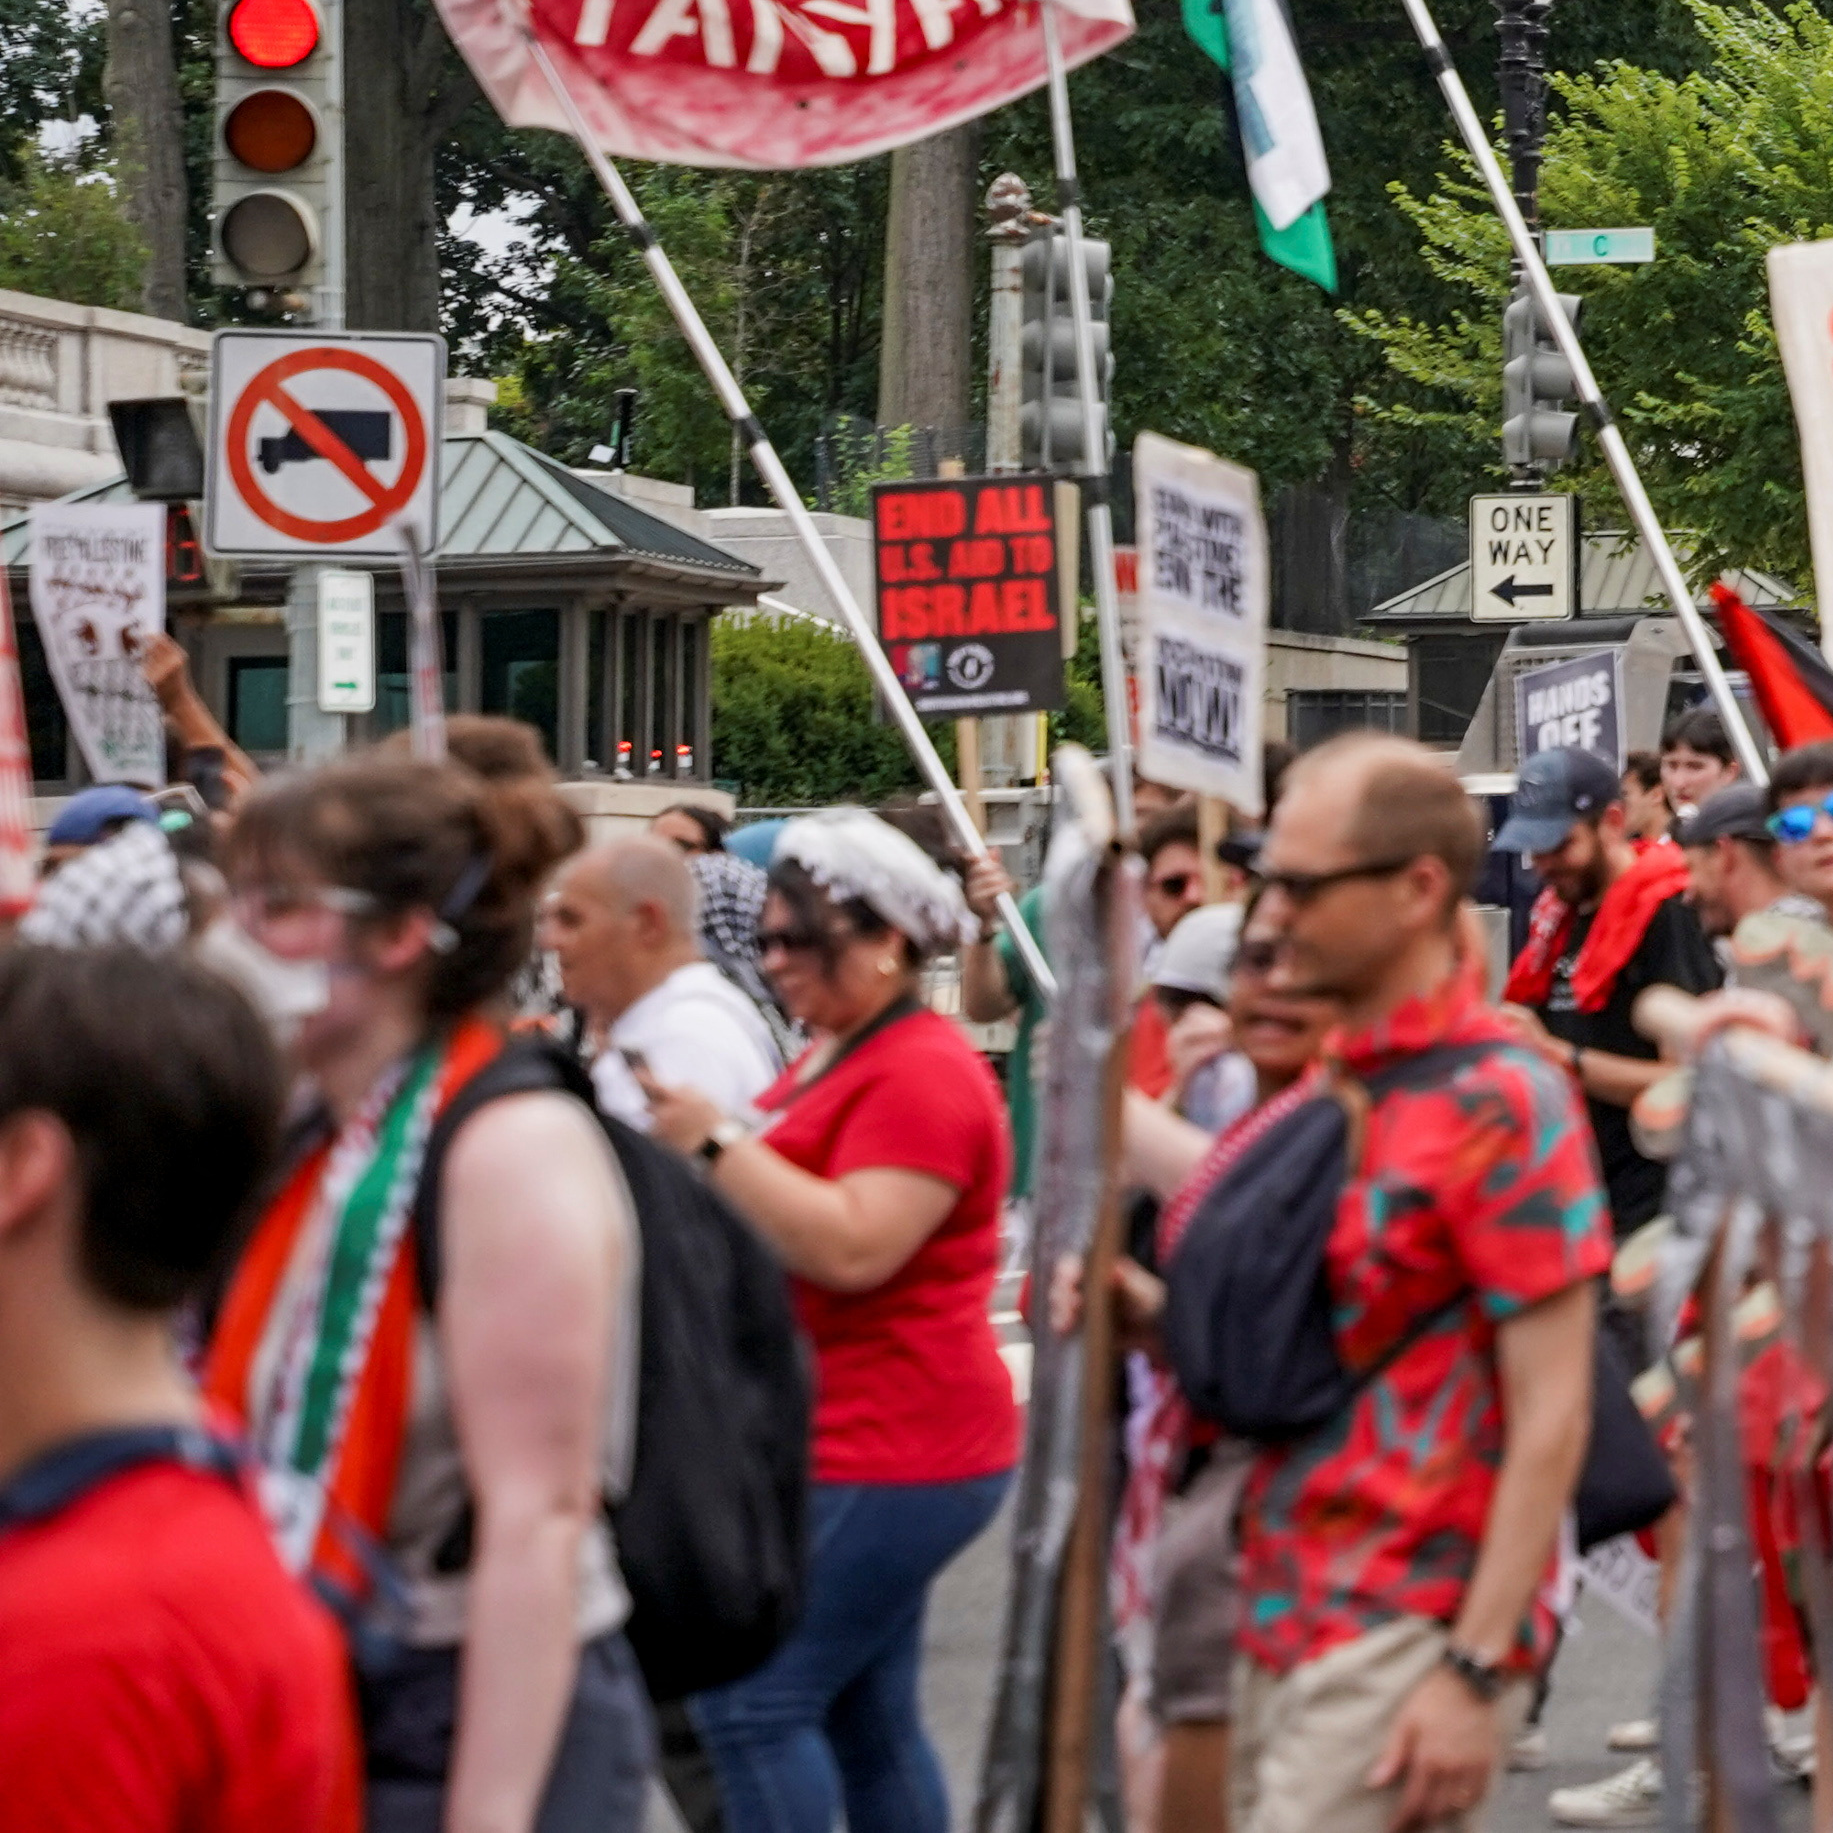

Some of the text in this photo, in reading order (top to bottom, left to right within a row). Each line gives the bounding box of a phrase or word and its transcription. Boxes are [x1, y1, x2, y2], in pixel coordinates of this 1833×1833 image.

[876, 483, 1054, 542] END ALL
[1490, 506, 1554, 533] ONE
[1007, 534, 1055, 575] TO
[1488, 539, 1555, 566] WAY
[881, 577, 1058, 642] ISRAEL
[1527, 669, 1613, 726] HANDS
